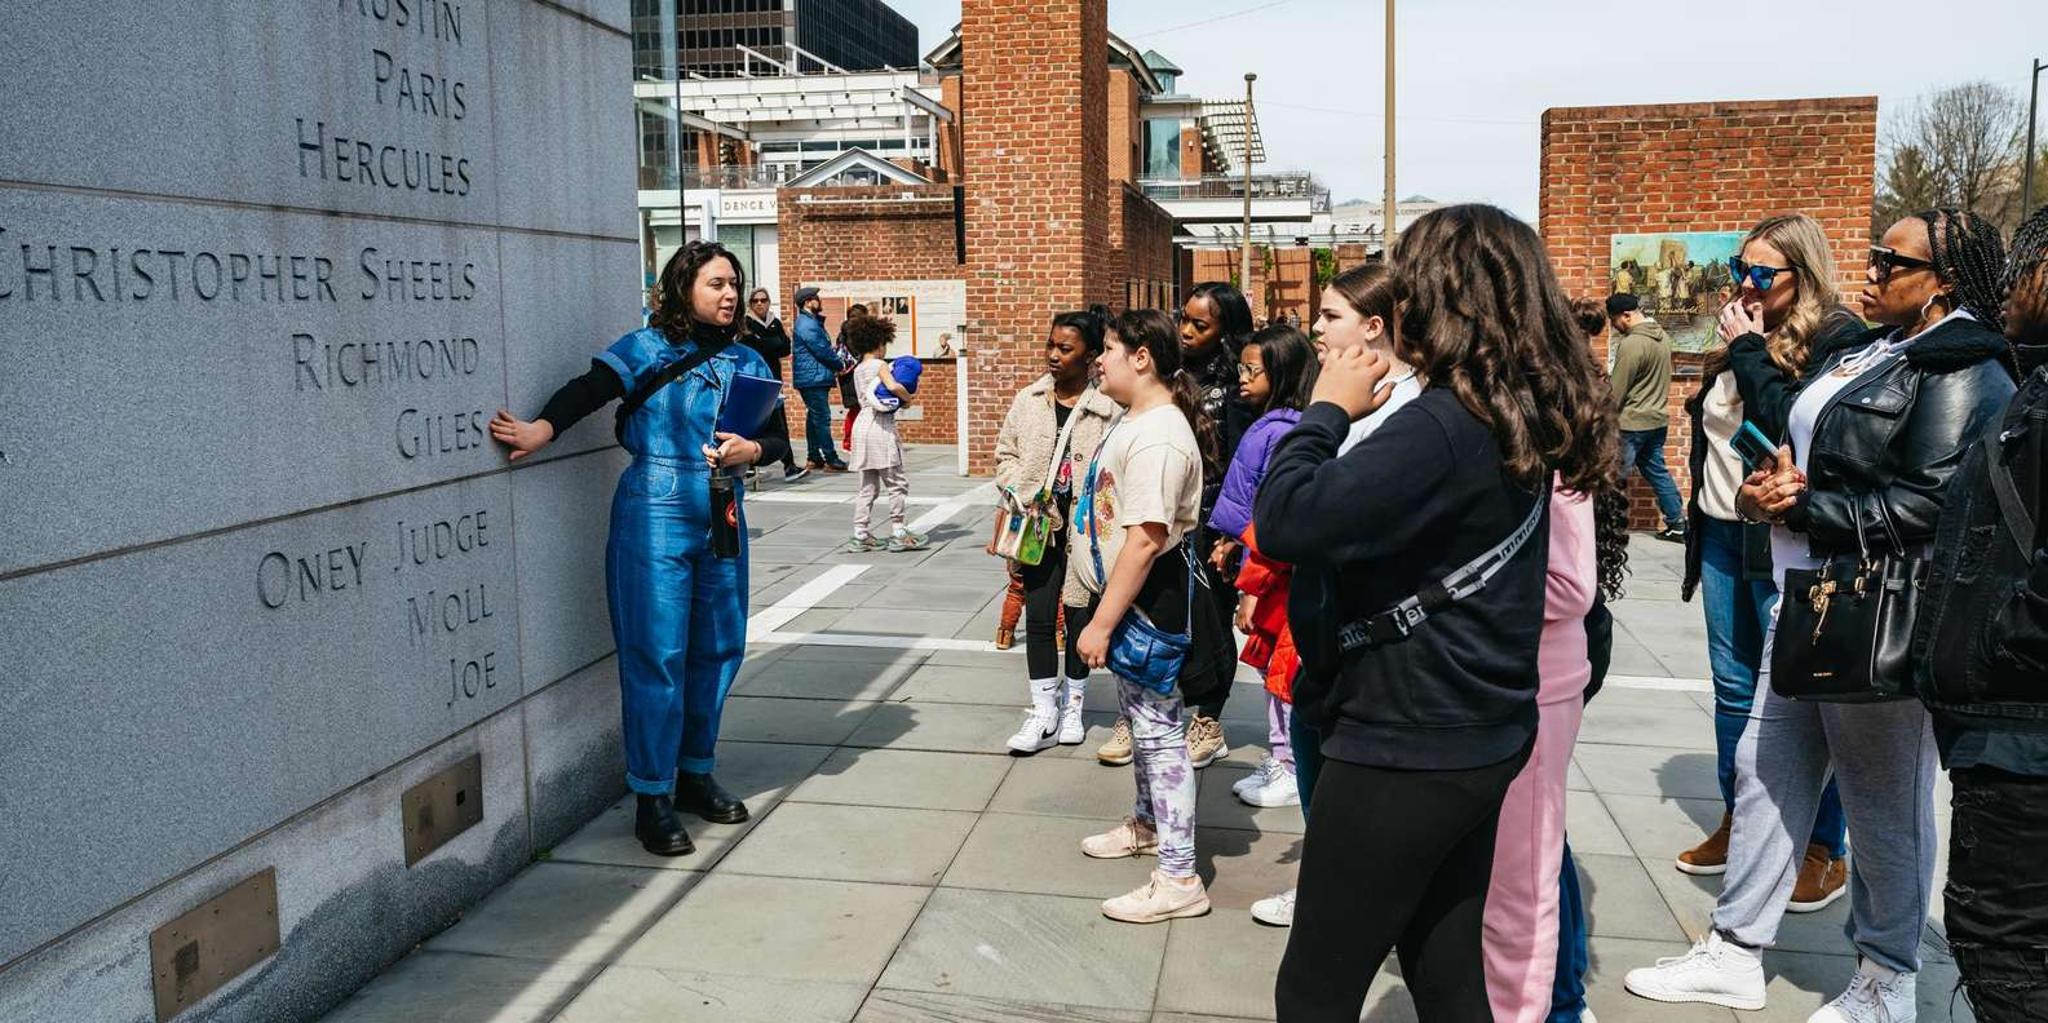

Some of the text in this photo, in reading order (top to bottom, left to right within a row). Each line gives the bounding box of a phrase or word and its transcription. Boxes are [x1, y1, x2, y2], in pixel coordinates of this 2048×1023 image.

[338, 0, 463, 47] USTIN
[372, 48, 467, 121] PARIS
[295, 118, 471, 197] HERCULES
[0, 226, 476, 302] HRISTOPHER SHEELS
[291, 332, 480, 393] RICHMOND
[395, 408, 484, 460] GILES
[256, 509, 489, 610] ONEY JUDGE
[406, 583, 494, 649] MOLL
[447, 651, 497, 709] JOE
